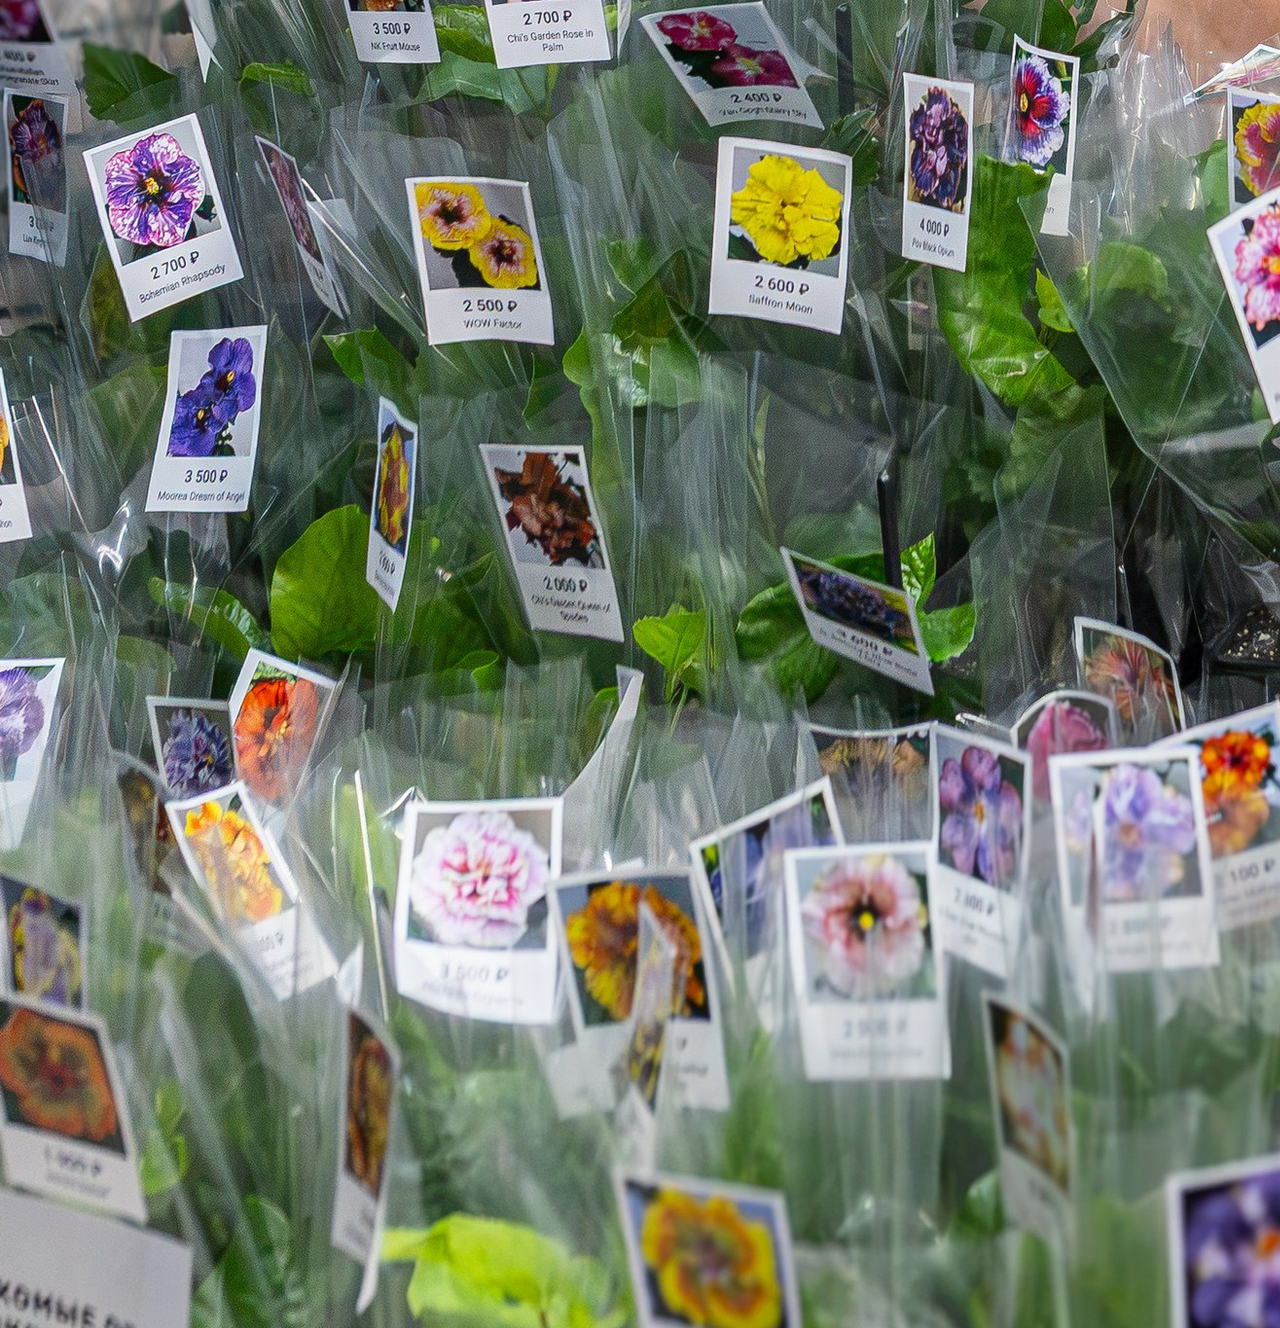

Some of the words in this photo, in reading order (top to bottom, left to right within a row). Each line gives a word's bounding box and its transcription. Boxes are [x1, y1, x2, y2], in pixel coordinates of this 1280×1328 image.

[523, 13, 532, 26] 2
[535, 10, 560, 24] 700
[372, 22, 380, 34] 3
[382, 22, 401, 35] 500
[507, 33, 528, 43] Chi's
[530, 31, 561, 42] Garden
[562, 30, 584, 39] Rose
[586, 29, 594, 37] in
[542, 43, 564, 52] Palm
[920, 217, 925, 229] 4
[926, 219, 942, 235] 000
[150, 267, 160, 280] 2
[163, 258, 187, 275] 700
[139, 282, 180, 303] Bohemian
[182, 263, 226, 284] Rhapsody
[754, 275, 764, 288] 2
[768, 277, 794, 293] 600
[464, 300, 473, 312] 2
[477, 299, 504, 312] 500
[749, 295, 784, 309] Saffron
[786, 301, 813, 315] Moon
[184, 470, 192, 483] 3
[196, 470, 217, 483] 500
[157, 491, 188, 501] Moorea
[190, 491, 215, 501] Dream
[216, 491, 224, 501] of
